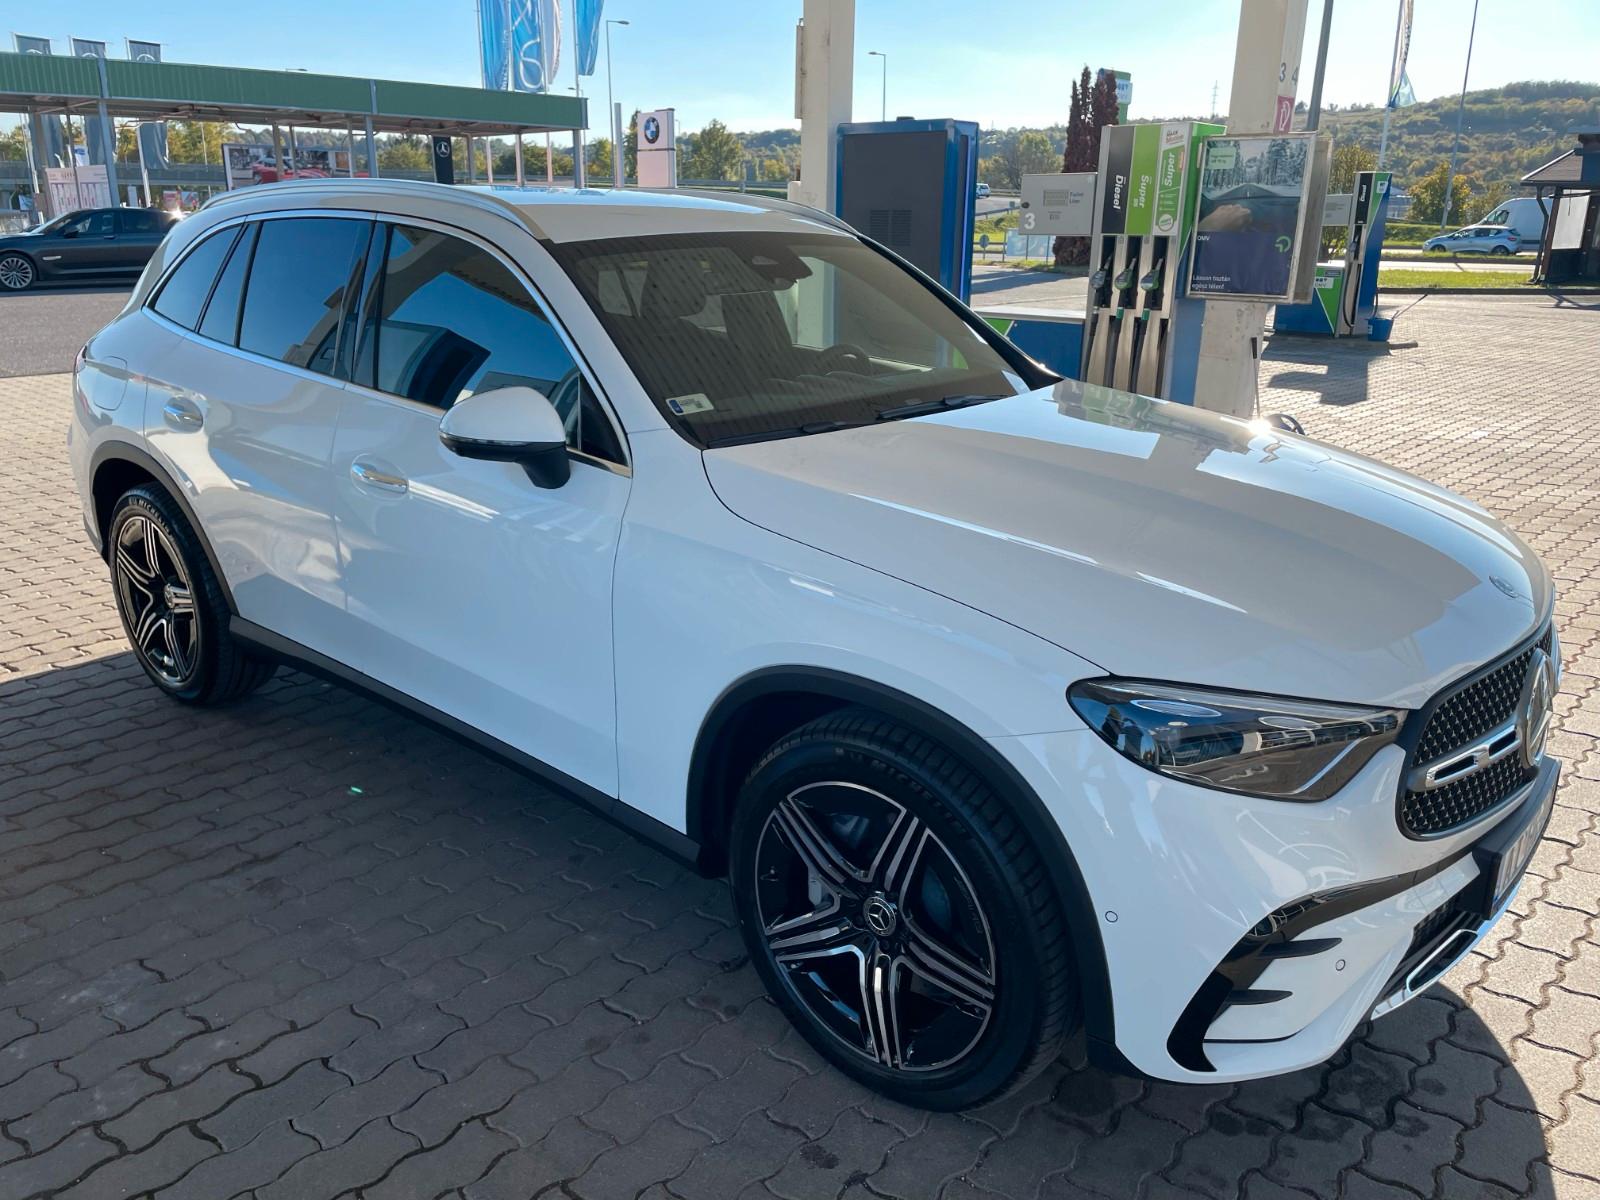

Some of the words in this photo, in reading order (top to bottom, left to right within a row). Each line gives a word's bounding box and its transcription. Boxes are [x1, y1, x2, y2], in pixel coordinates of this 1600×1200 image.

[1280, 62, 1287, 82] 3
[1165, 152, 1175, 187] Super
[1113, 174, 1124, 210] Diesel
[1139, 175, 1150, 209] Super
[1024, 212, 1036, 230] 3
[870, 757, 971, 841] MICHELIN
